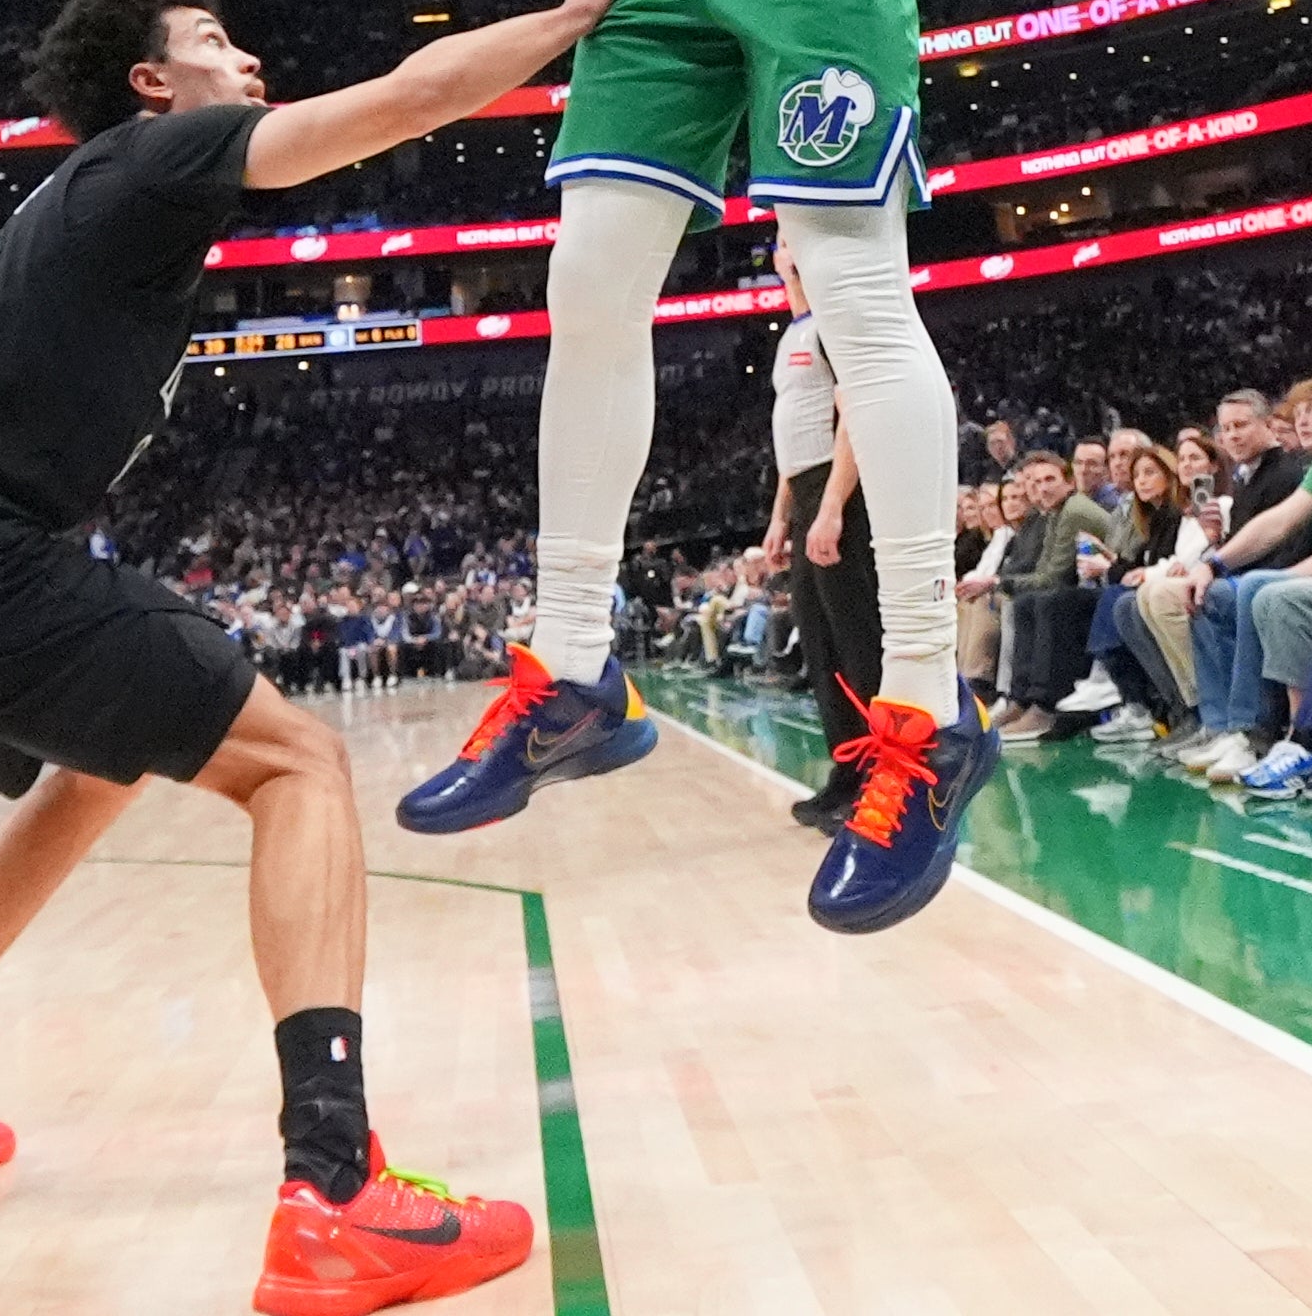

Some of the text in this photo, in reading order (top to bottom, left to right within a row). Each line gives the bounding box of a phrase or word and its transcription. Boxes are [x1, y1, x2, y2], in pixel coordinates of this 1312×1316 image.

[974, 21, 1013, 45] BUT
[1021, 112, 1257, 174] NOTHING BUT ONE-OF-A-KIND
[456, 229, 515, 246] NOTHING
[516, 224, 544, 242] BUT
[1159, 224, 1216, 245] NOTHING
[1216, 218, 1242, 236] BUT
